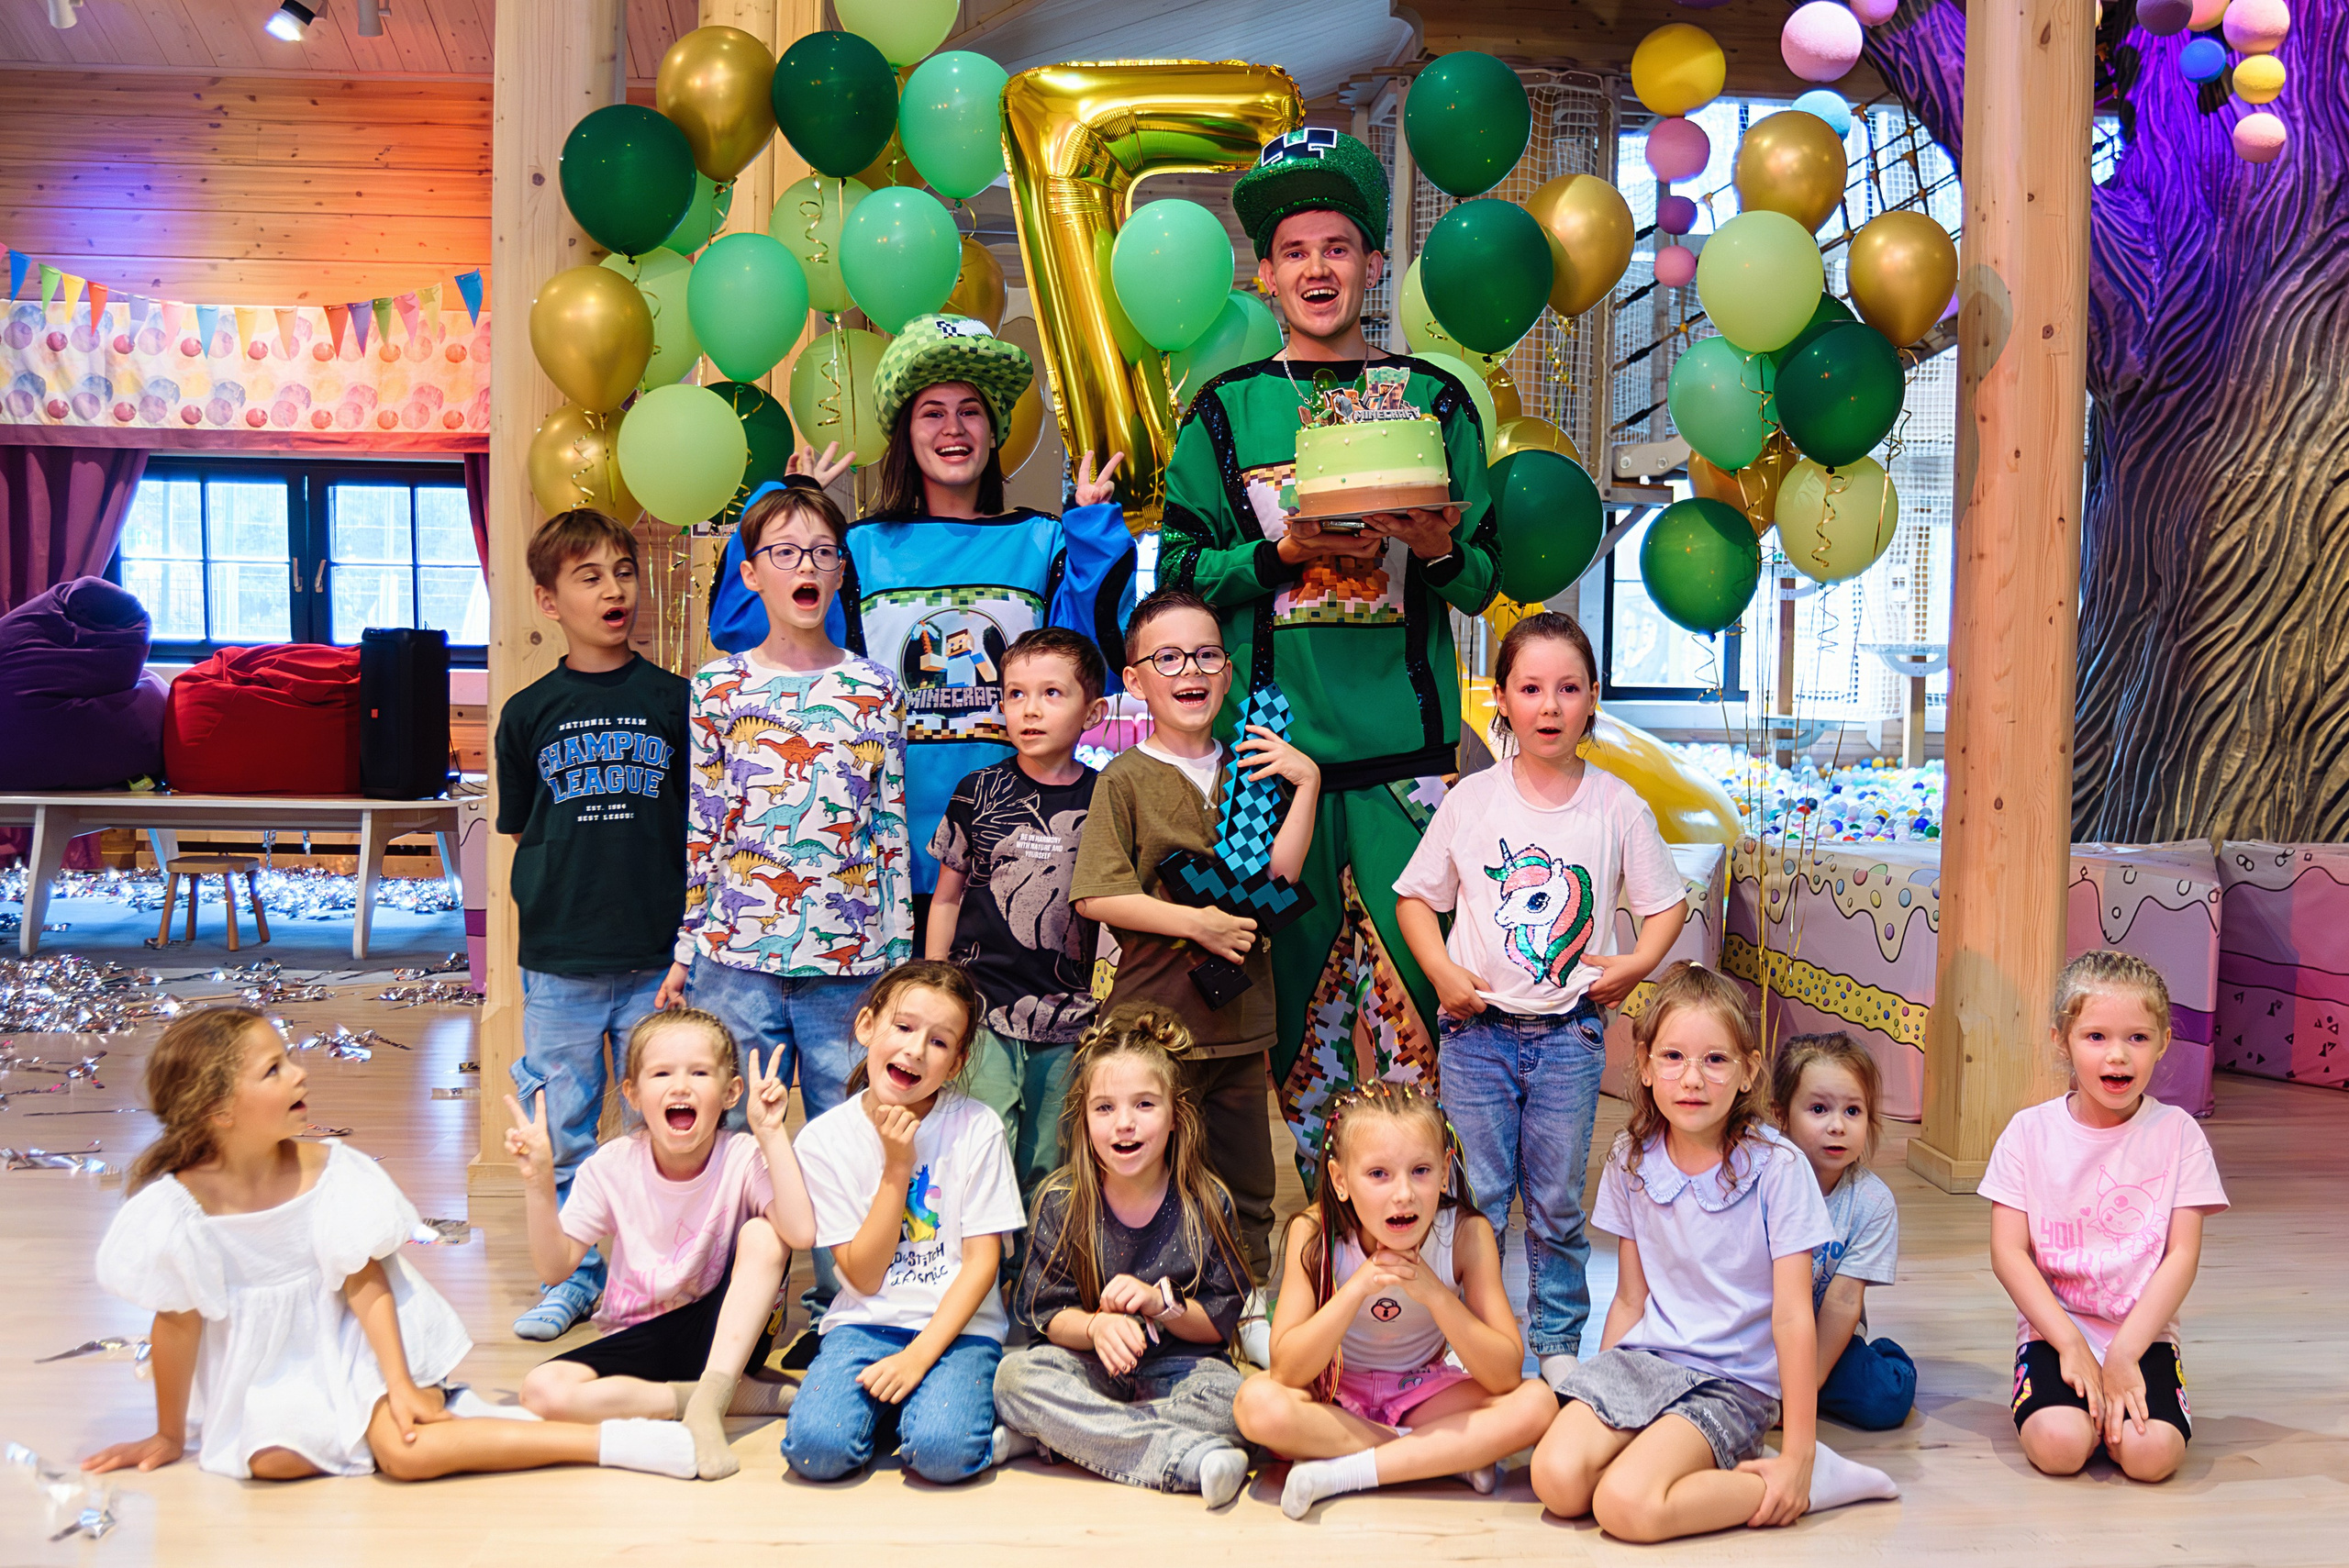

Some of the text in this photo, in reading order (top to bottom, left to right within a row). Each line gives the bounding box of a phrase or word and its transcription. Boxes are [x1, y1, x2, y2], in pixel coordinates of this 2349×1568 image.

[1353, 408, 1420, 423] MINECRAFT
[559, 717, 647, 731] NATIONAL TEAM
[547, 765, 664, 804] LEAGUE
[577, 814, 599, 822] BEST
[1029, 834, 1034, 842] IN
[1035, 835, 1062, 844] HARMONY
[1016, 840, 1063, 852] WITH NATURE AND
[1025, 851, 1052, 860] YOURSELF
[2040, 1216, 2084, 1251] YOU
